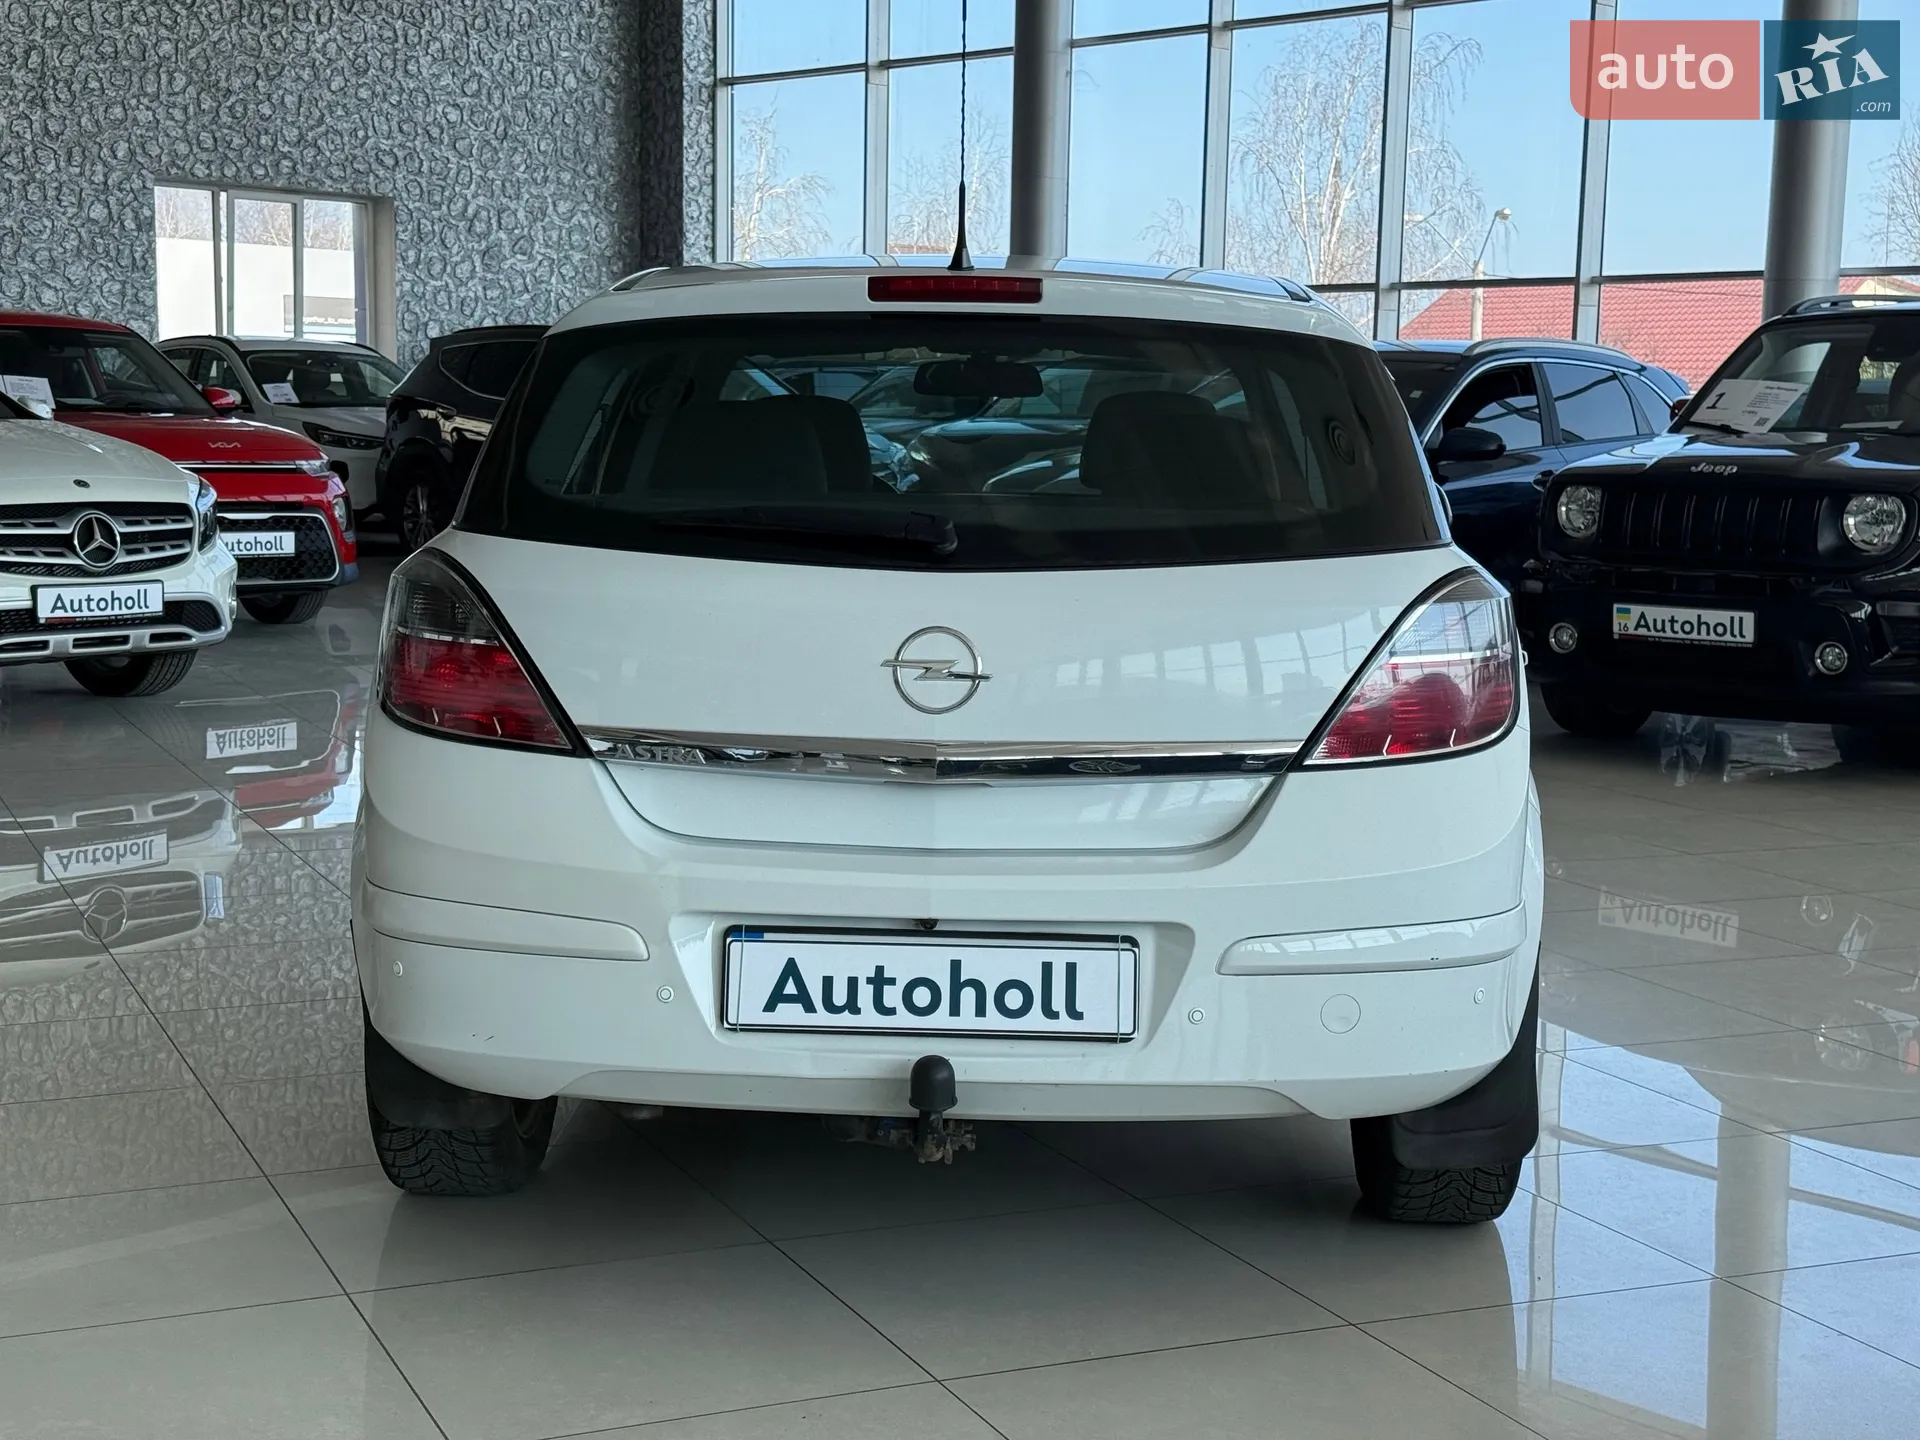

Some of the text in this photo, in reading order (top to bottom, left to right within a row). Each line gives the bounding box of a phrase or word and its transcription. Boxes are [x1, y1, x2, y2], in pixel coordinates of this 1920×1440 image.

[1706, 392, 1726, 410] 1
[1690, 462, 1738, 477] Jeep
[225, 535, 284, 553] utoholl
[49, 588, 150, 614] Autoholl
[1617, 610, 1747, 639] 16 Autoholl
[614, 743, 707, 765] ASTRA
[761, 957, 1085, 1021] Autoholl
